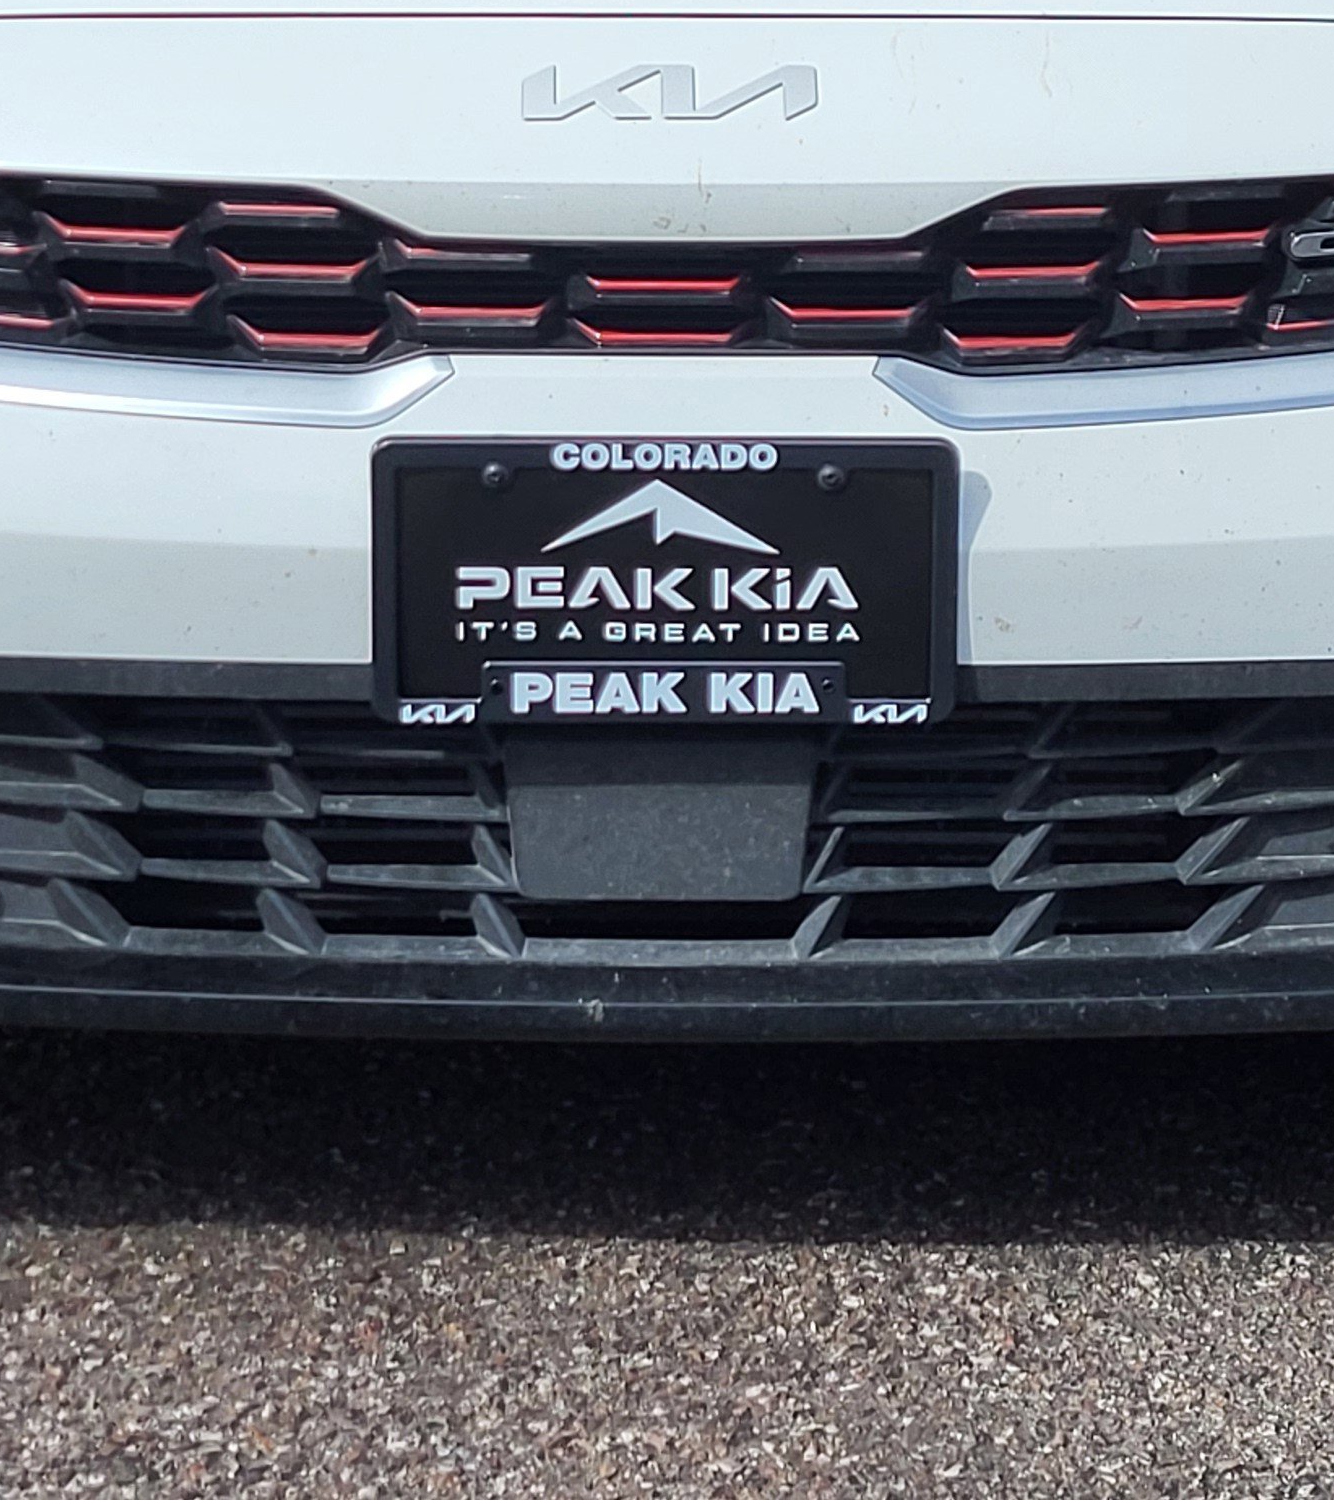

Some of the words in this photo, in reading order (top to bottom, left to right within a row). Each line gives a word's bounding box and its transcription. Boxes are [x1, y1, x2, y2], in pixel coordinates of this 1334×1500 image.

[521, 63, 819, 122] KIA
[551, 442, 779, 471] COLORADO
[455, 565, 696, 612] PEAK
[455, 620, 538, 642] IT'S
[558, 620, 583, 642] A
[604, 621, 742, 643] GREAT
[763, 621, 861, 643] IDEA
[510, 671, 688, 714] PEAK
[707, 671, 821, 714] KIA
